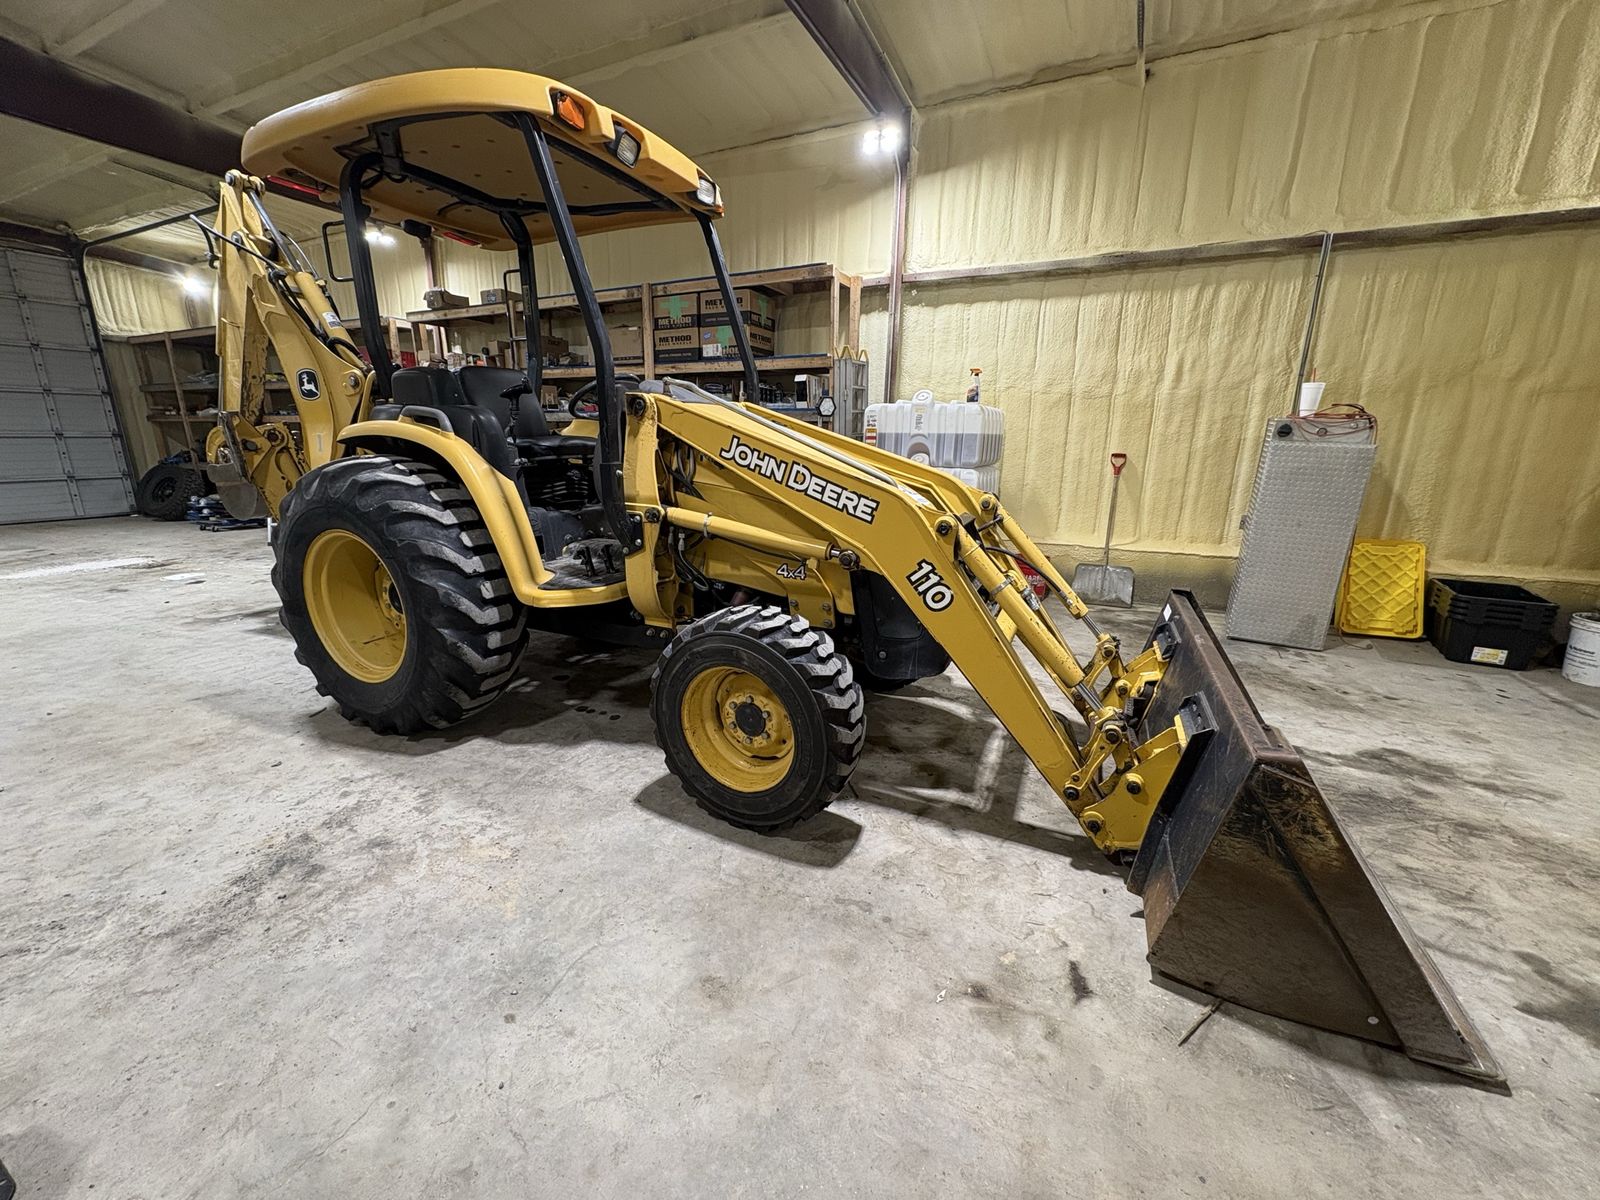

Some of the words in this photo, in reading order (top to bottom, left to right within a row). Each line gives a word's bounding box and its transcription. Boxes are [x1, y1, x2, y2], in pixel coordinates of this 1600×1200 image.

[705, 297, 743, 306] METD
[658, 334, 692, 343] METHOD
[719, 435, 788, 484] JOHN
[786, 461, 880, 524] DEERE
[776, 563, 806, 581] 4x4
[906, 559, 954, 613] 110
